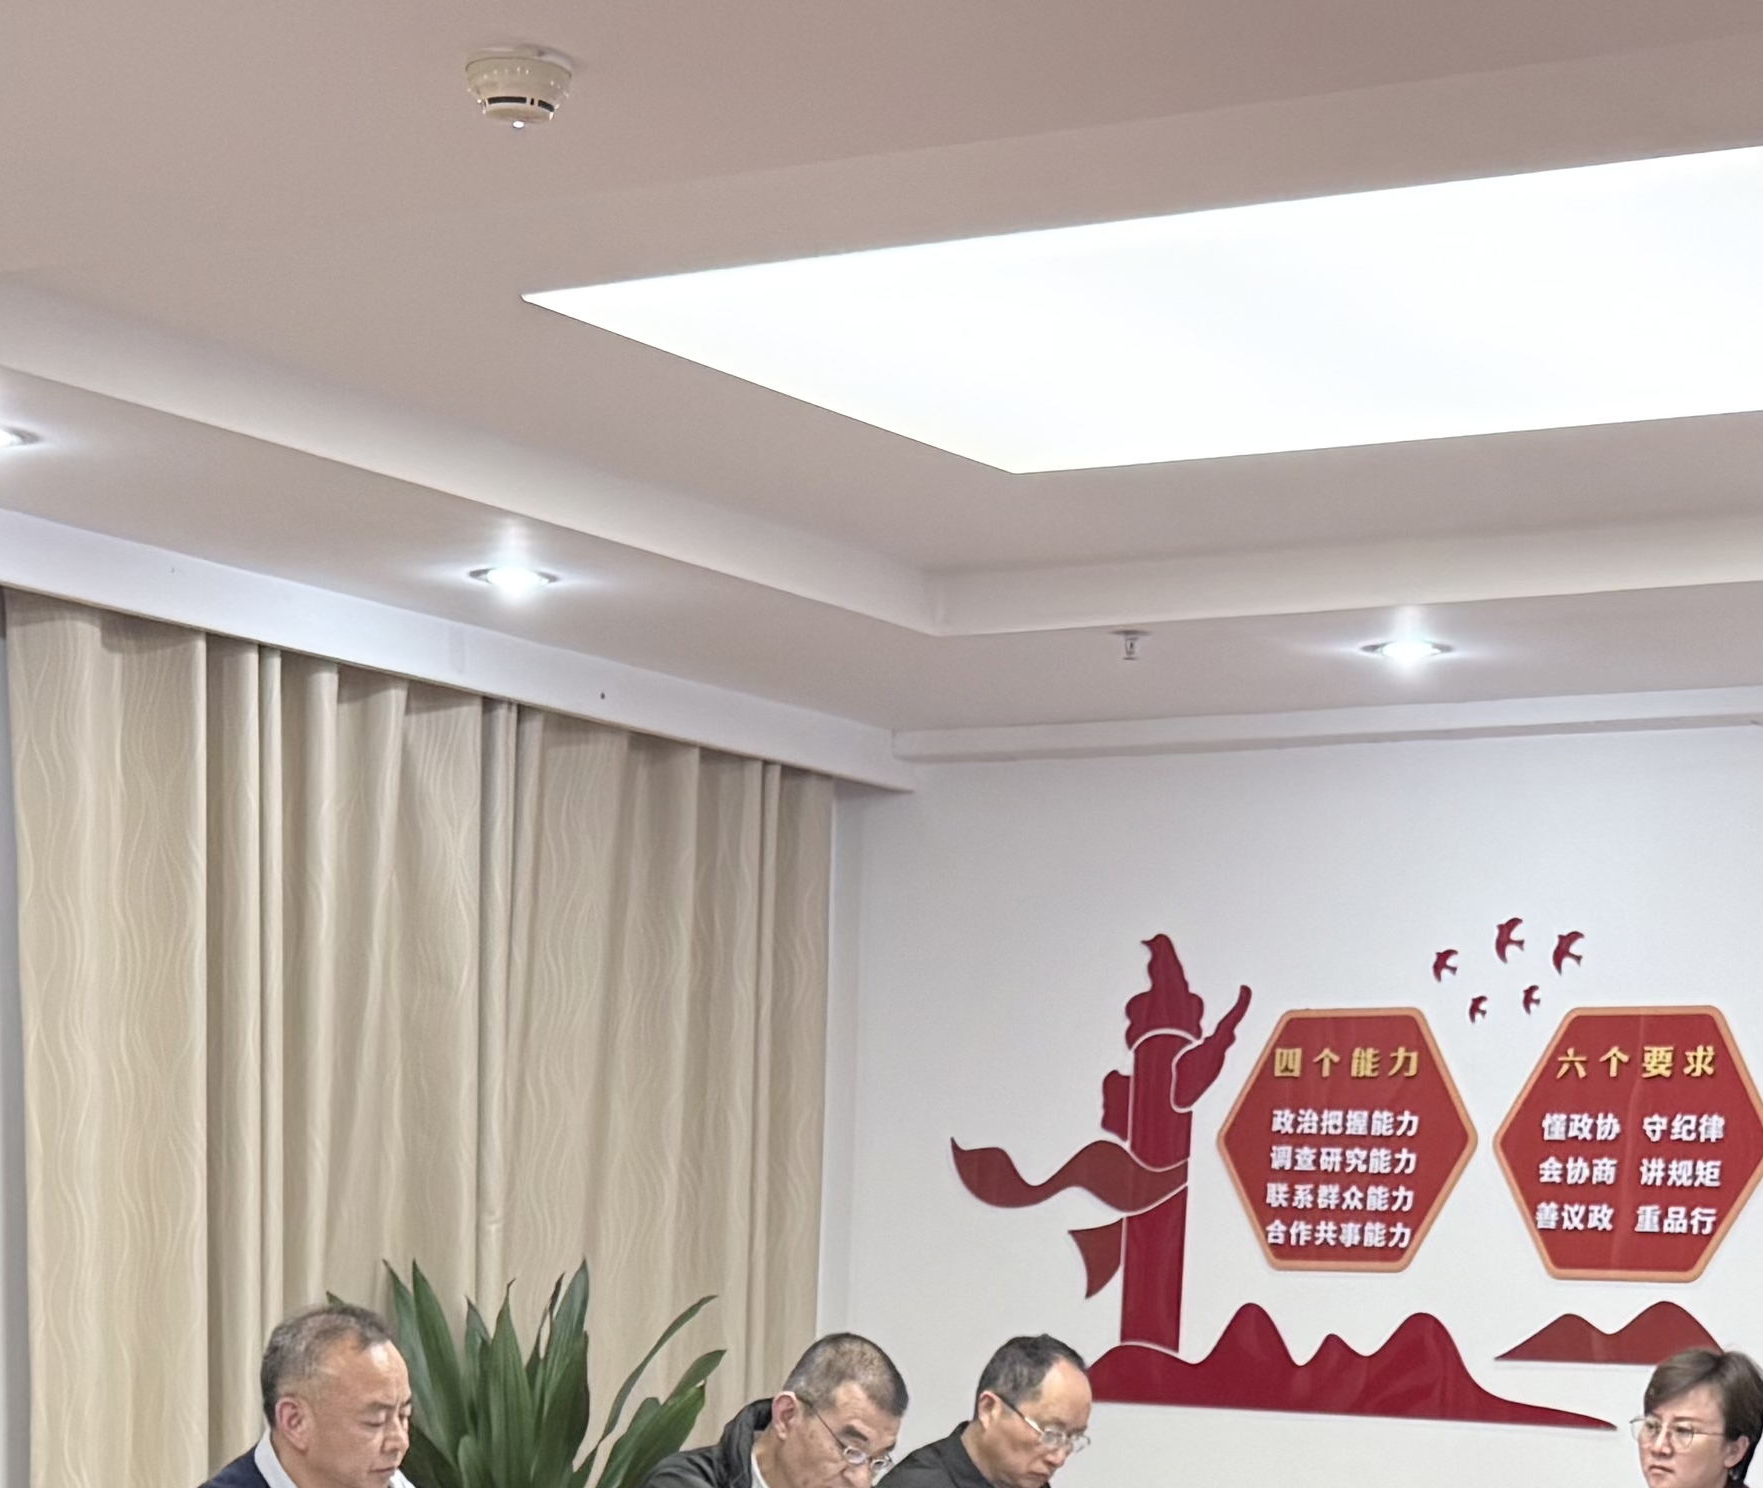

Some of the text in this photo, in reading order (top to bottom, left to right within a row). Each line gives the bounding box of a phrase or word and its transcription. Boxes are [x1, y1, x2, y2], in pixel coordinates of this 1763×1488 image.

[1273, 1046, 1419, 1079] 四个能力
[1556, 1045, 1717, 1079] 六个要求
[1271, 1108, 1419, 1137] 政治把握能力
[1541, 1112, 1726, 1143] 懂政协 守纪律
[1270, 1145, 1417, 1175] 调查研究能力
[1538, 1156, 1722, 1188] 会协商 讲规矩
[1265, 1182, 1414, 1211] 联系群众能力
[1266, 1221, 1412, 1248] 合作共事能力
[1535, 1202, 1718, 1236] 善议政 重品行
